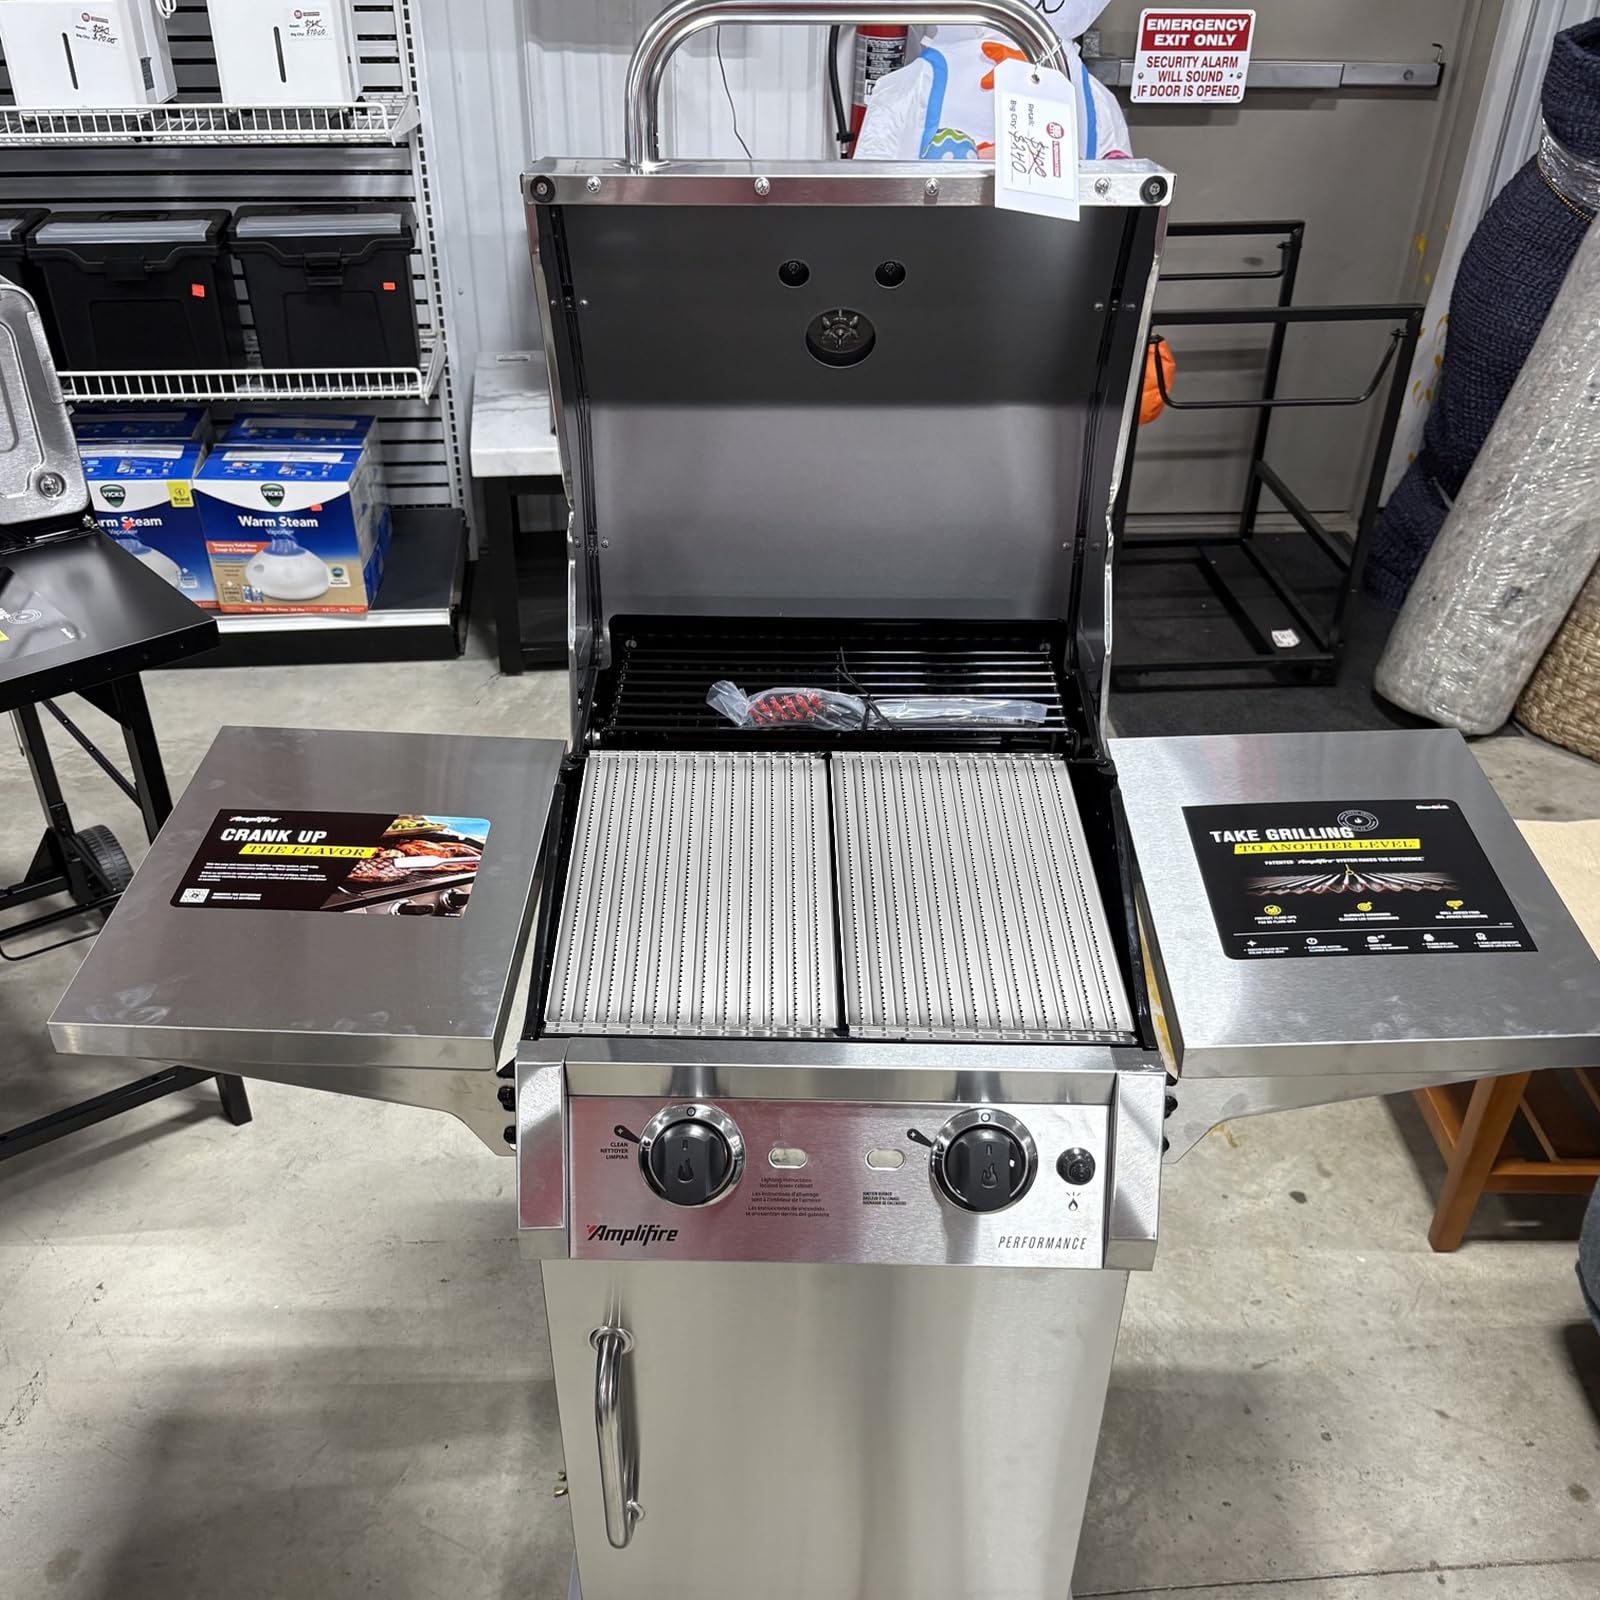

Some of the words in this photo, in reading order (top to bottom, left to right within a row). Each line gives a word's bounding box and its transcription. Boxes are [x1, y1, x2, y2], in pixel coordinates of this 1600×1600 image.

[1146, 18, 1249, 31] EMERGENCY
[1154, 34, 1190, 46] EXIT
[1194, 34, 1237, 46] ONLY
[1146, 56, 1199, 68] SECURITY
[1201, 56, 1239, 68] ALARM
[1158, 71, 1184, 82] WILL
[1186, 71, 1224, 82] SOUND
[1137, 85, 1148, 97] IF
[1150, 85, 1180, 97] DOOR
[1183, 85, 1194, 97] IS
[1197, 85, 1240, 97] OPENED
[1009, 99, 1017, 112] Big
[237, 516, 276, 527] Warm
[278, 516, 319, 528] Steam
[220, 828, 292, 842] CRANK
[297, 831, 327, 843] UP
[1209, 830, 1260, 843] TAKE
[1265, 826, 1354, 841] GRILLING
[249, 845, 289, 853] THE
[291, 845, 365, 856] FLAVOR
[1239, 844, 1263, 852] TO
[1269, 841, 1353, 851] ANOTHER
[1357, 840, 1413, 849] LEVEL
[586, 1224, 679, 1247] Amplifire
[998, 1235, 1088, 1250] PERFORMANCE
